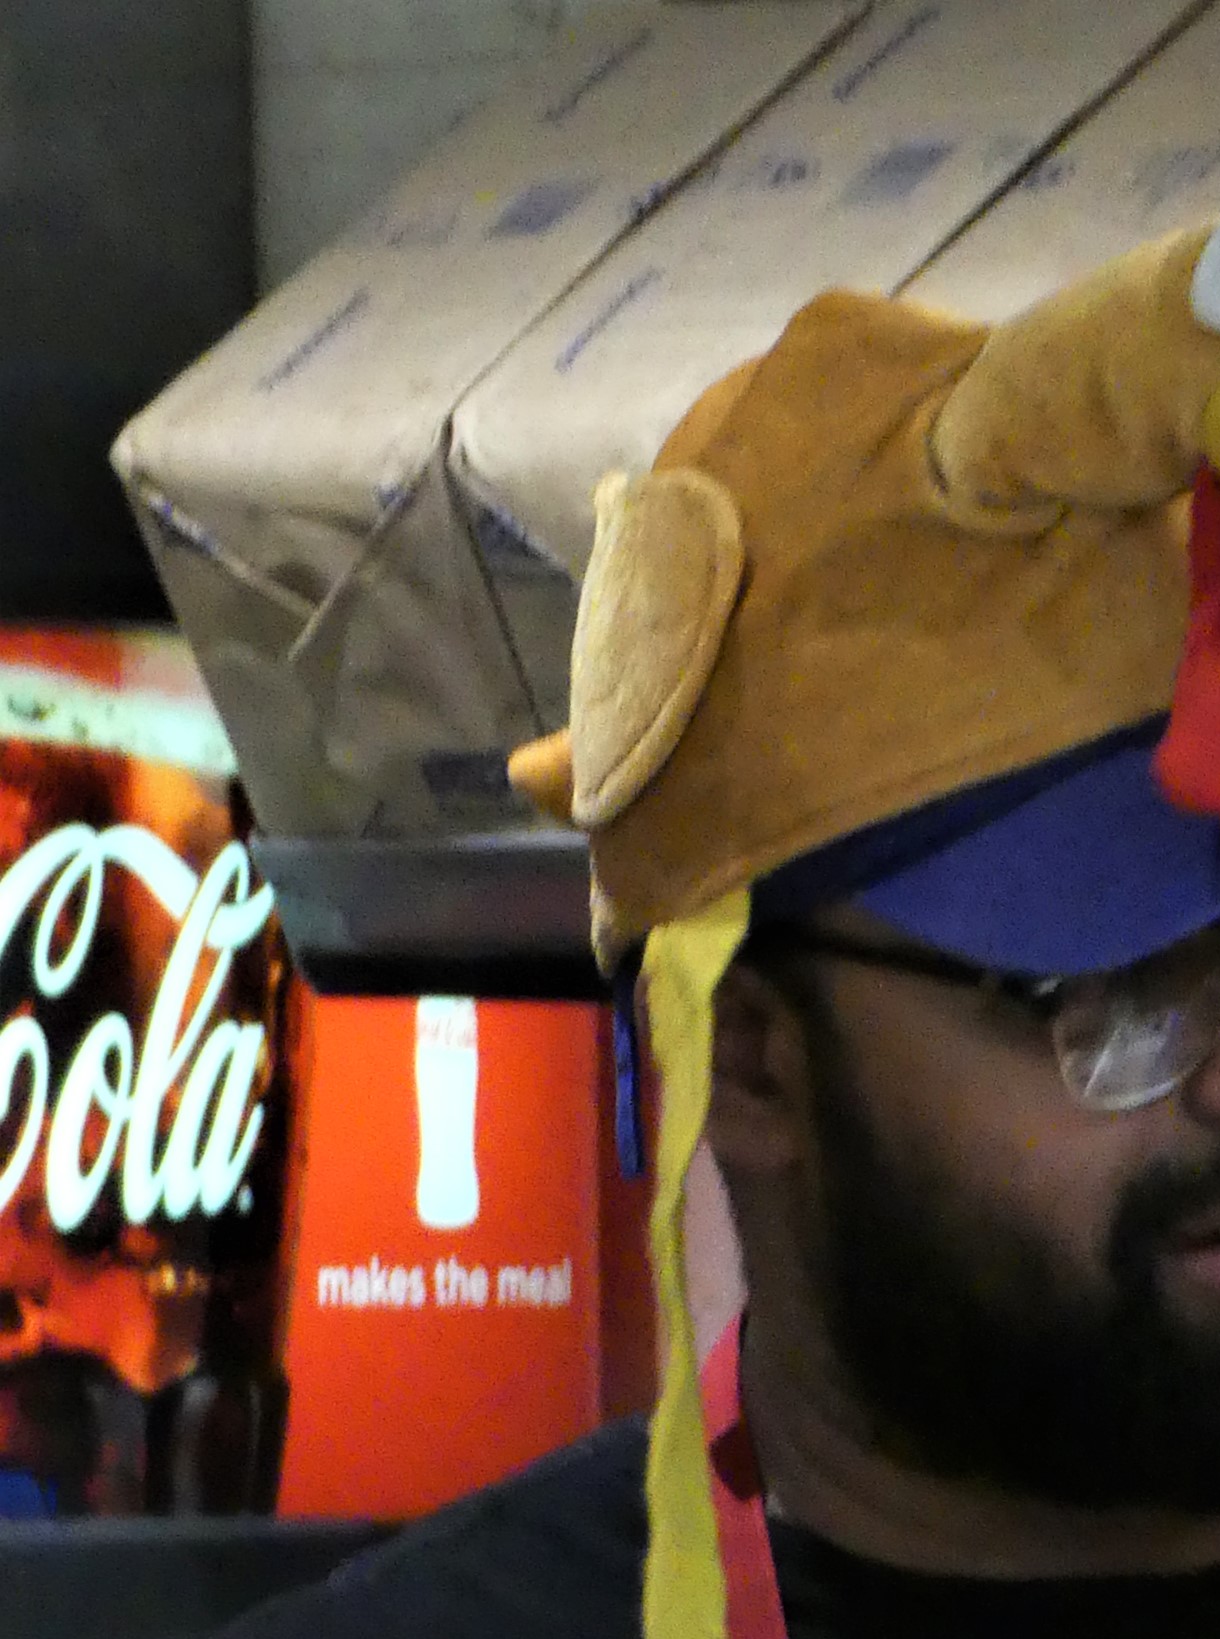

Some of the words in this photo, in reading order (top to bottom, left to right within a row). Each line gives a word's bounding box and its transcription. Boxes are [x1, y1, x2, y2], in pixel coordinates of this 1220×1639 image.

[318, 1253, 426, 1307] makes
[435, 1253, 489, 1308] the
[497, 1254, 572, 1308] meal
